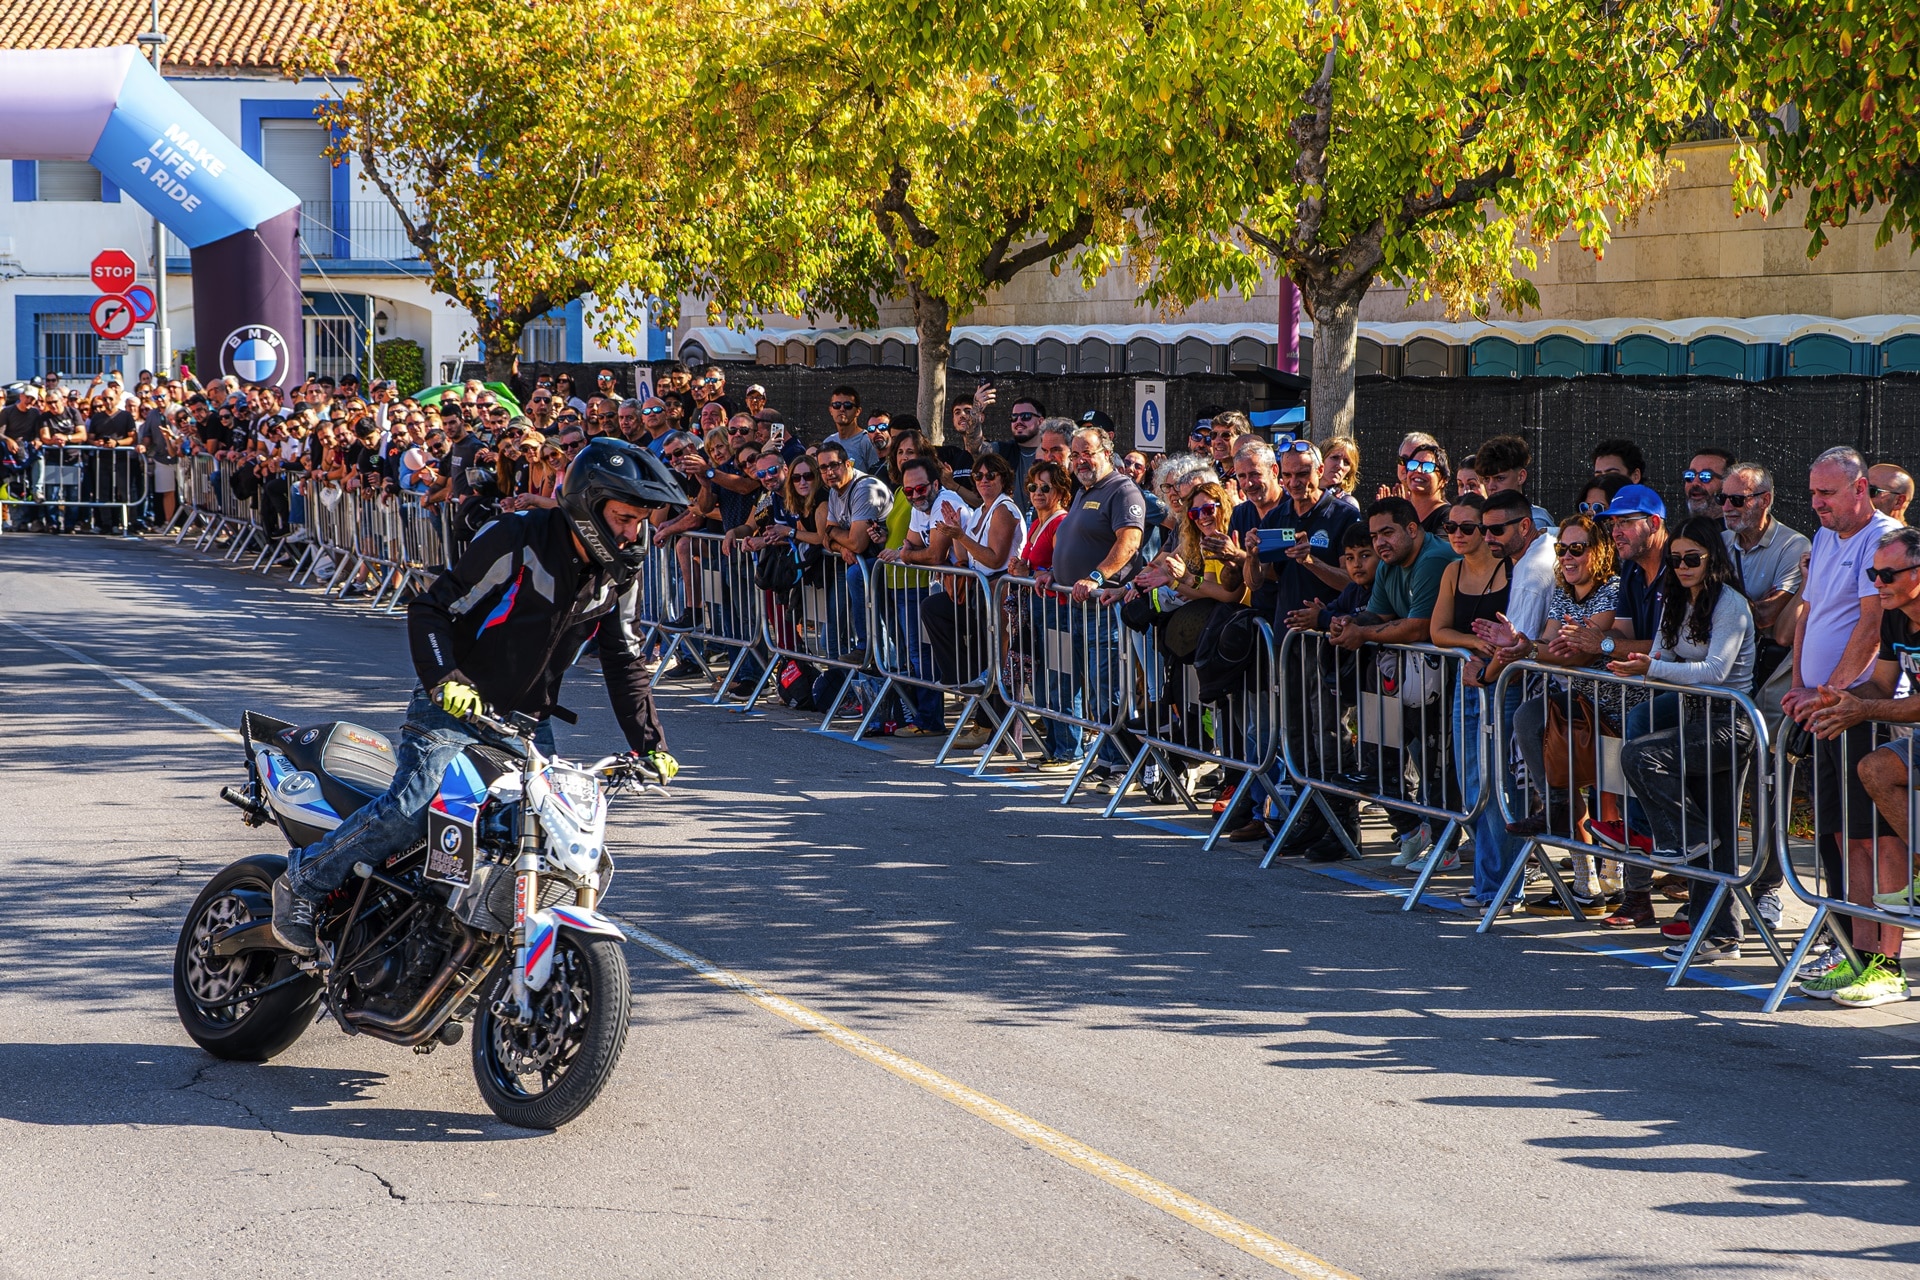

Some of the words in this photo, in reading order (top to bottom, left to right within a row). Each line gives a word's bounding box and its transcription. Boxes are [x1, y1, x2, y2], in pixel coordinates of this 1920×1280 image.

[148, 138, 196, 180] LIFE
[164, 123, 226, 178] MAKE
[131, 156, 152, 175] A
[149, 168, 202, 213] RIDE
[94, 266, 133, 278] STOP
[228, 328, 281, 349] BMW
[277, 758, 295, 772] BMW
